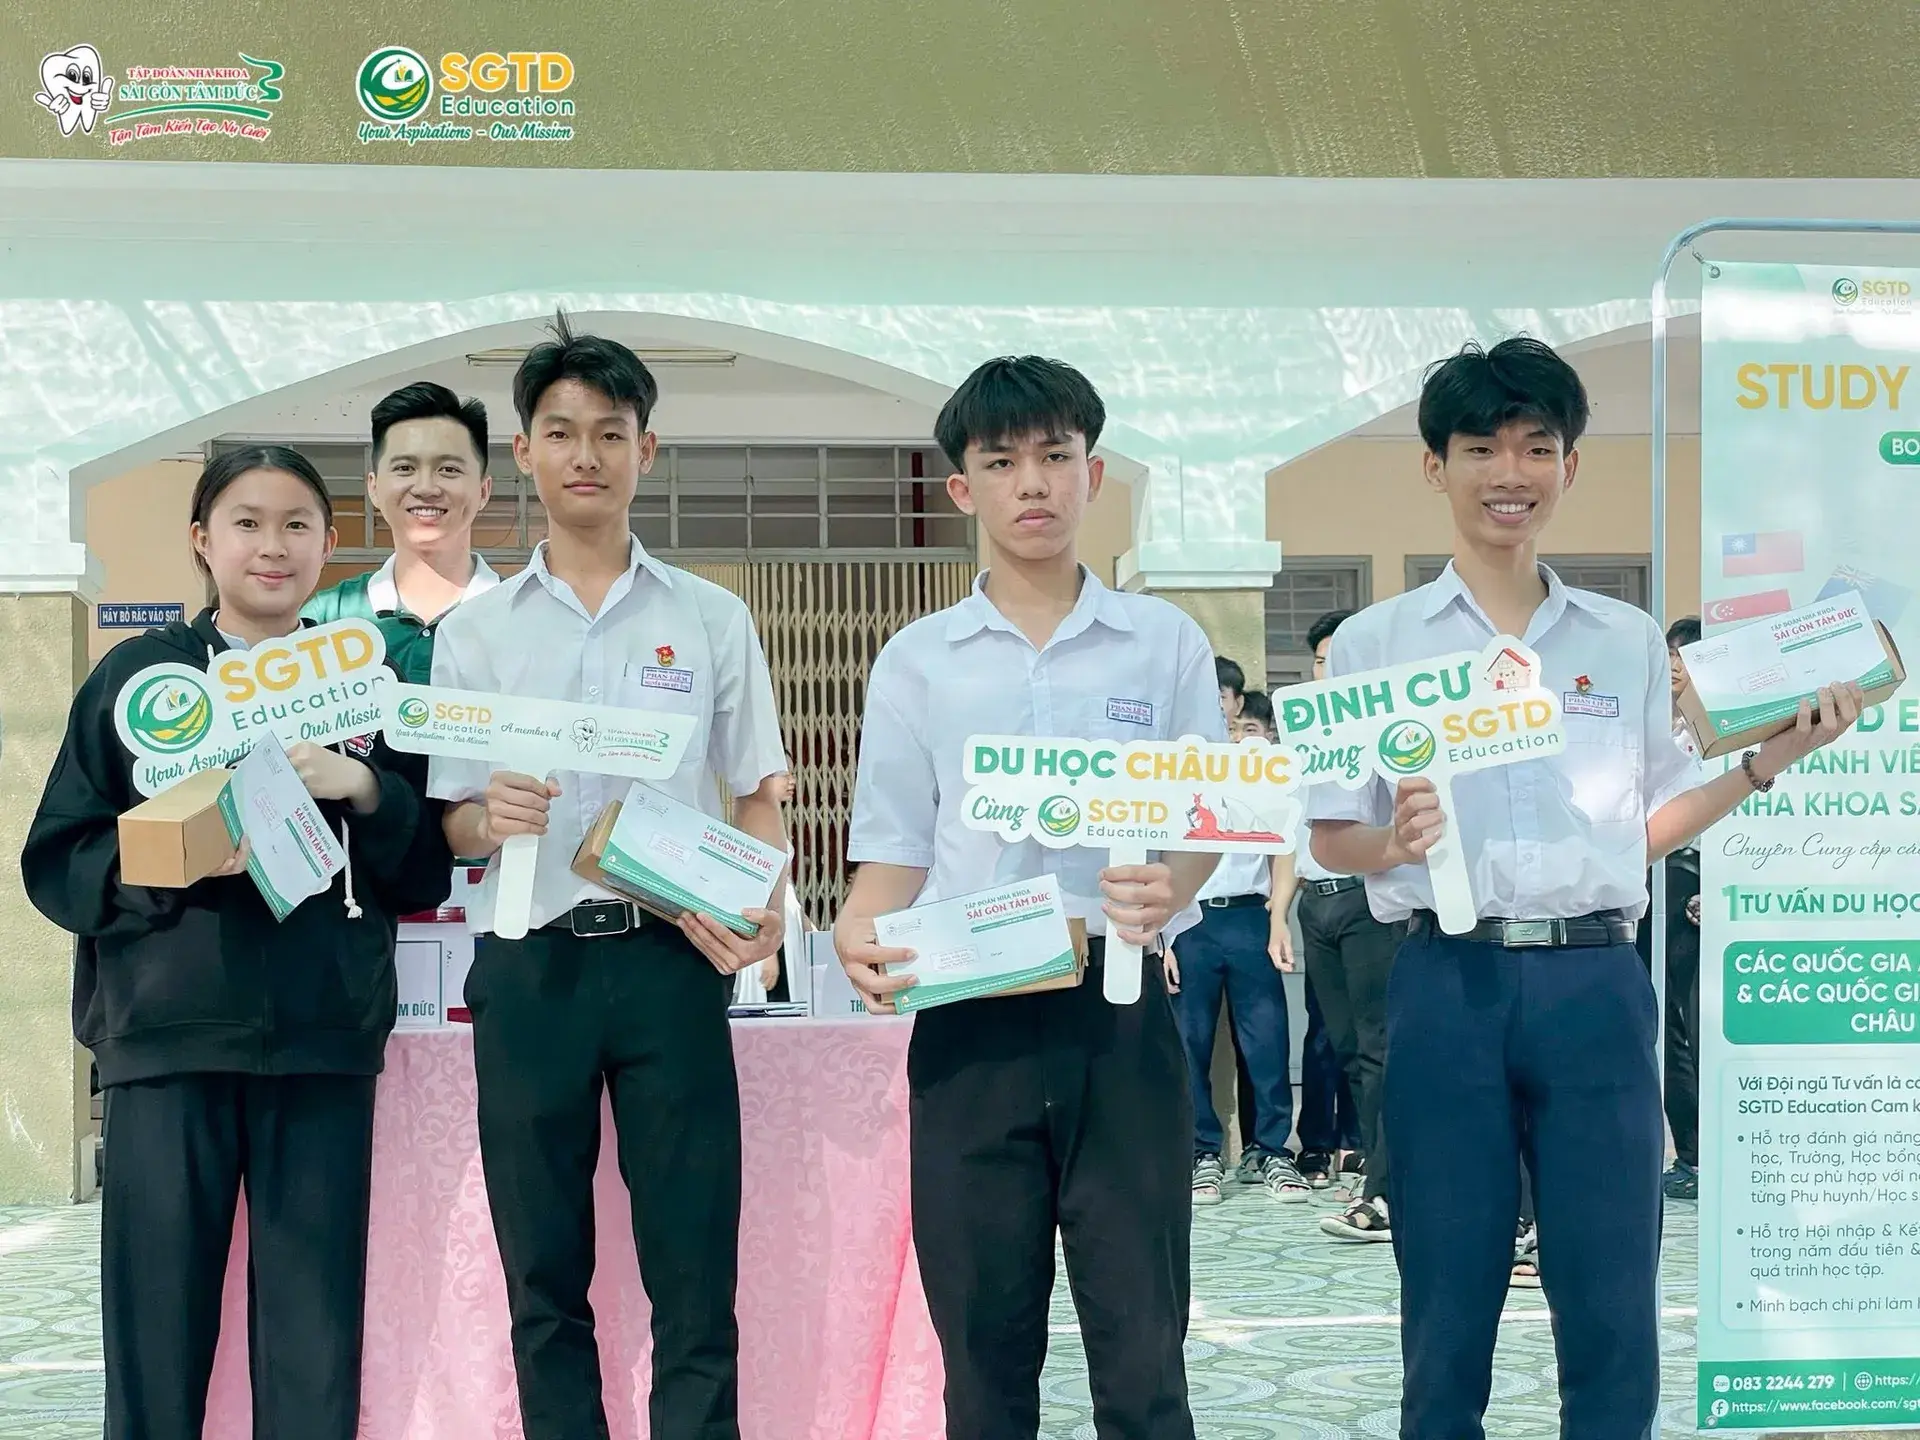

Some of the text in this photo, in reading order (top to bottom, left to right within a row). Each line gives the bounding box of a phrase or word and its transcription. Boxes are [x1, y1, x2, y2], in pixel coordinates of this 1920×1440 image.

[1862, 280, 1911, 296] SGTD
[1861, 297, 1912, 306] Education
[1735, 362, 1911, 410] STUDY
[131, 607, 147, 622] RÁC
[219, 628, 374, 703] SGTD
[1283, 660, 1472, 737] ĐỊNH CƯ
[434, 703, 492, 724] SGTD
[1442, 699, 1552, 744] SGTD
[433, 721, 492, 735] Education
[500, 723, 562, 741] A member of
[145, 762, 186, 788] Your
[300, 720, 331, 740] Our
[1449, 732, 1559, 763] Education
[974, 746, 1290, 786] DU HỌC CHÂU ÚC
[971, 795, 1029, 831] Cùng
[1088, 799, 1168, 824] SGTD
[1732, 791, 1795, 816] NHA
[1804, 791, 1890, 816] KHOA
[1087, 825, 1169, 839] Education
[1723, 833, 1797, 870] Chuyên
[1802, 832, 1857, 870] Cung
[1859, 839, 1892, 870] cấp
[1740, 892, 1772, 914] TƯ
[1777, 886, 1825, 913] VẤN
[1833, 894, 1865, 913] DU
[1735, 949, 1786, 973] CÁC
[1792, 946, 1864, 973] QUỐC
[1870, 952, 1912, 973] GIA
[1737, 976, 1920, 1004] & CÁC QUỐC GI
[412, 1000, 435, 1016] ĐỨC
[1851, 1008, 1915, 1033] CHÂU
[1738, 1076, 1762, 1091] Với
[1767, 1076, 1793, 1095] Đội
[1798, 1077, 1828, 1093] ngũ
[1832, 1076, 1851, 1090] Tư
[1853, 1074, 1883, 1090] vấn
[1887, 1075, 1901, 1090] là
[1738, 1099, 1909, 1114] SGTD Education Cam
[1752, 1129, 1772, 1145] Hỗ
[1779, 1133, 1800, 1147] trợ
[1807, 1131, 1847, 1145] đánh
[1853, 1132, 1877, 1147] giá
[1752, 1151, 1783, 1167] học,
[1789, 1150, 1845, 1167] Trường,
[1852, 1150, 1881, 1166] Học
[1751, 1168, 1904, 1186] Định cư phù hợp với
[1751, 1187, 1907, 1206] từng Phụ huynh/Học
[1750, 1223, 1771, 1239] Hỗ
[1778, 1226, 1799, 1241] trợ
[1806, 1225, 1830, 1241] Hội
[1836, 1224, 1875, 1241] nhập
[1882, 1223, 1892, 1237] &
[1751, 1245, 1792, 1261] trong
[1799, 1244, 1832, 1257] năm
[1875, 1242, 1903, 1256] tiên
[1750, 1265, 1780, 1280] quá
[1823, 1263, 1850, 1279] học
[1855, 1263, 1884, 1279] tập.
[1750, 1299, 1785, 1313] Minh
[1790, 1298, 1828, 1314] bạch
[1885, 1297, 1913, 1310] làm
[1732, 1376, 1762, 1391] 083
[1765, 1375, 1804, 1390] 2244
[1807, 1374, 1835, 1389] 279
